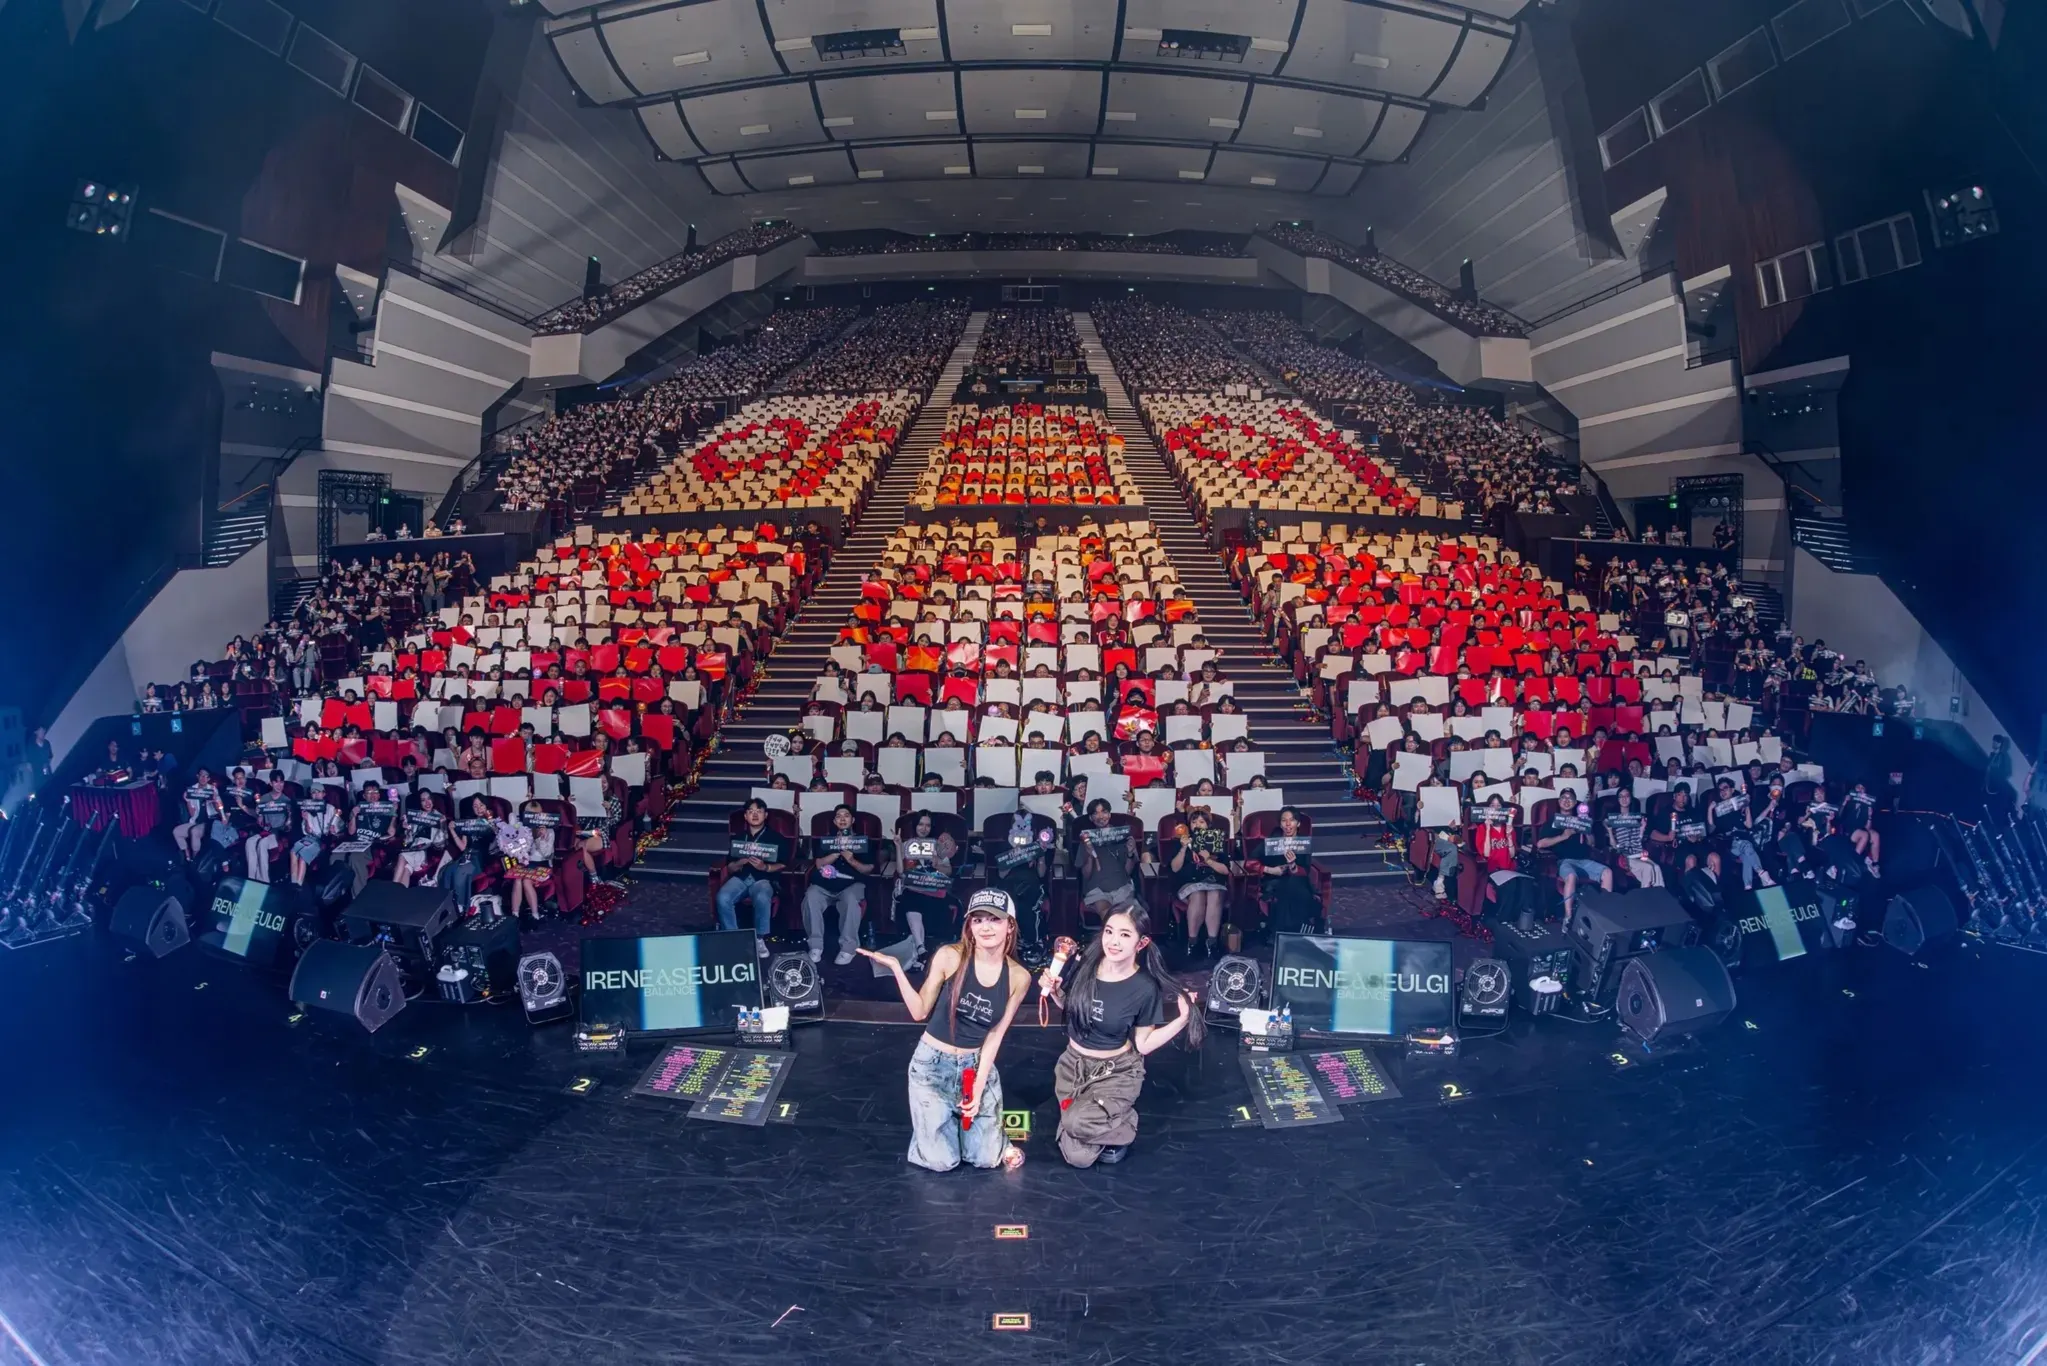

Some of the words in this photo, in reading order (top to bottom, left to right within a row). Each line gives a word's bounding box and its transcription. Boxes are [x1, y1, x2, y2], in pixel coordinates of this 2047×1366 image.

[644, 986, 697, 996] BALANCE
[1842, 989, 1855, 998] 5
[960, 998, 994, 1016] BALANCE
[1744, 1020, 1758, 1030] 4
[411, 1046, 428, 1058] 3
[1611, 1053, 1629, 1065] 3
[571, 1078, 592, 1092] 2
[1443, 1084, 1463, 1098] 2
[779, 1103, 791, 1117] 1
[1237, 1106, 1252, 1120] 1
